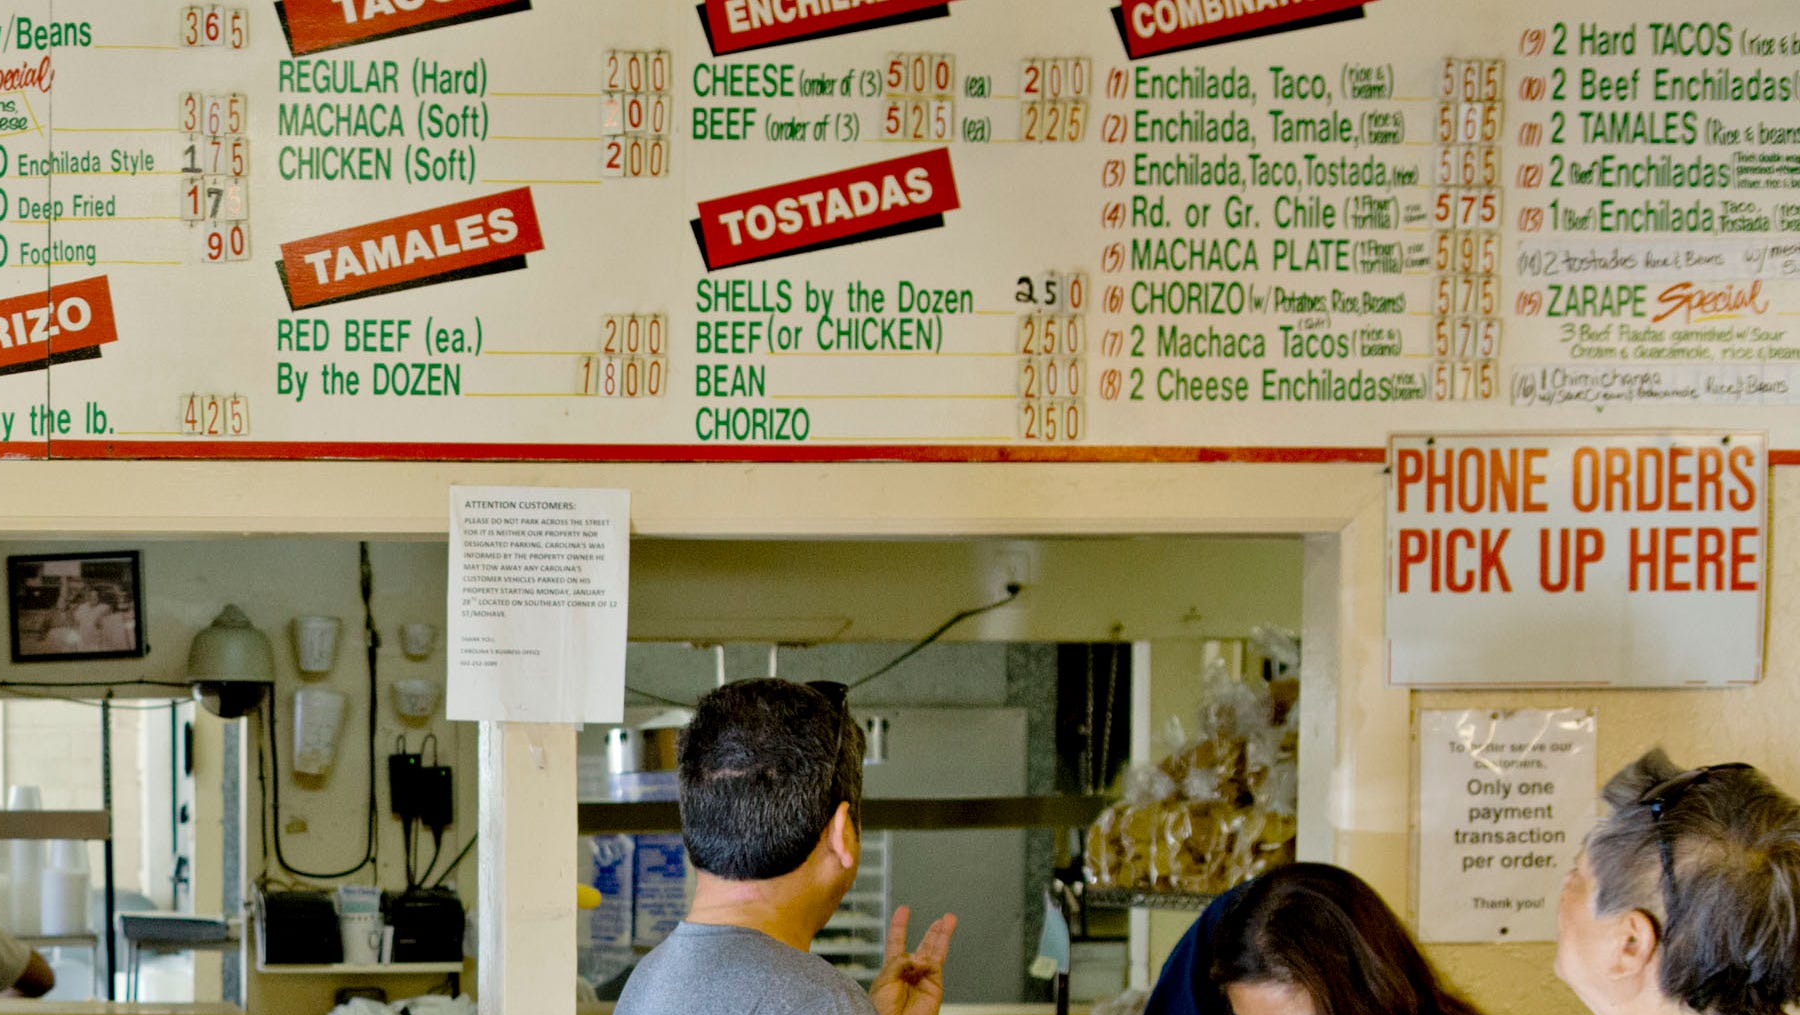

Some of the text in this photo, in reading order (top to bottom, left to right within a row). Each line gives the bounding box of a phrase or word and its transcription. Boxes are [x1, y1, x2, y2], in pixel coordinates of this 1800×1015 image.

[1552, 22, 1732, 56] 2 Hard TACOS
[279, 57, 487, 97] REGULAR (Hard)
[1133, 67, 1332, 104] Enchilada, Taco,
[1580, 68, 1792, 101] Beef Enchiladas
[1025, 105, 1081, 141] 225
[1580, 111, 1698, 144] TAMALES
[18, 151, 101, 177] Enchilada
[111, 150, 154, 174] Style
[279, 144, 475, 184] CHICKEN (Soft)
[718, 167, 933, 246] TOSTADAS
[304, 207, 519, 285] TAMALES
[1132, 240, 1351, 271] MACHACA PLATE
[696, 279, 973, 320] SHELLS by the Dozen
[1547, 280, 1769, 324] ZARAPE Special
[277, 316, 482, 356] RED BEEF (ea.)
[1130, 325, 1349, 358] 2 Machaca Tacos
[696, 365, 765, 396] BEAN
[30, 402, 71, 434] the
[86, 402, 114, 434] lb.
[1397, 446, 1756, 513] PHONE ORDERS
[465, 501, 576, 510] ATTENTION CUSTOMERS:
[491, 518, 502, 526] DO
[504, 518, 519, 526] NOT
[521, 518, 539, 526] PARK
[1399, 528, 1758, 593] PICK UP HERE
[1467, 779, 1554, 799] Only one
[1469, 805, 1553, 823] payment
[1454, 829, 1565, 844] transaction
[1462, 853, 1557, 872] per order.
[1473, 898, 1545, 911] Thank you!
